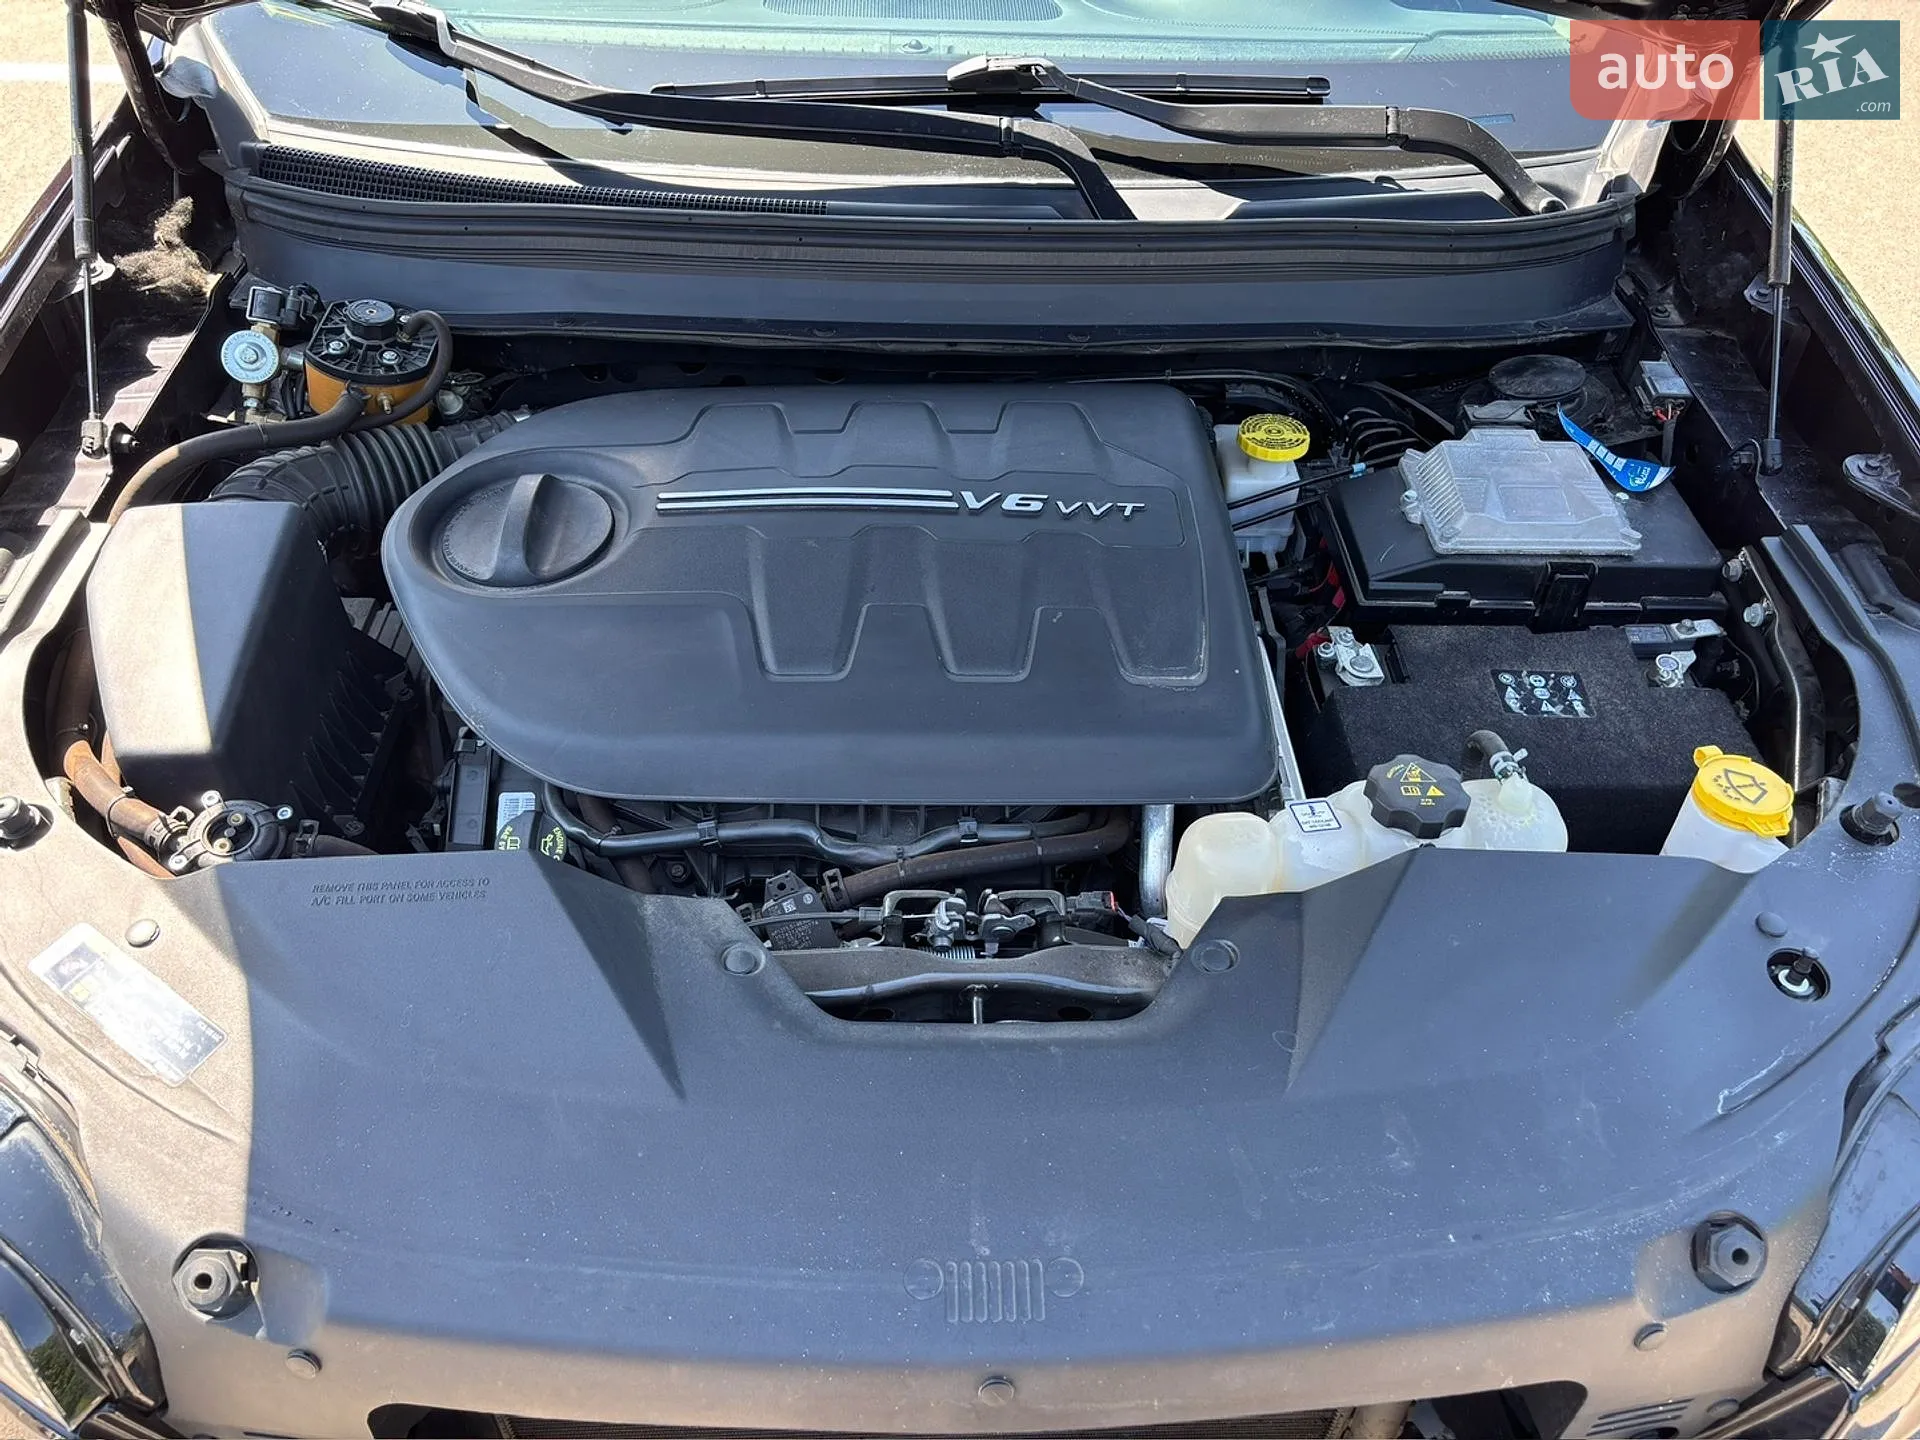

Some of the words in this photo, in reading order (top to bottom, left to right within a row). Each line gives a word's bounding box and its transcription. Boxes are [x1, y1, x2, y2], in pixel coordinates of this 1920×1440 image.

[960, 490, 1049, 512] V6
[1056, 501, 1145, 517] VVT
[312, 882, 354, 893] REMOVE
[357, 882, 379, 892] THIS
[381, 880, 412, 891] PANEL
[414, 880, 435, 889] FOR
[436, 878, 475, 888] ACCESS
[477, 877, 490, 886] TO
[311, 896, 330, 906] A/C
[335, 896, 356, 905] FILL
[359, 895, 385, 904] PORT
[389, 894, 405, 903] ON
[406, 892, 436, 901] SOME
[438, 890, 486, 900] VEHICLES
